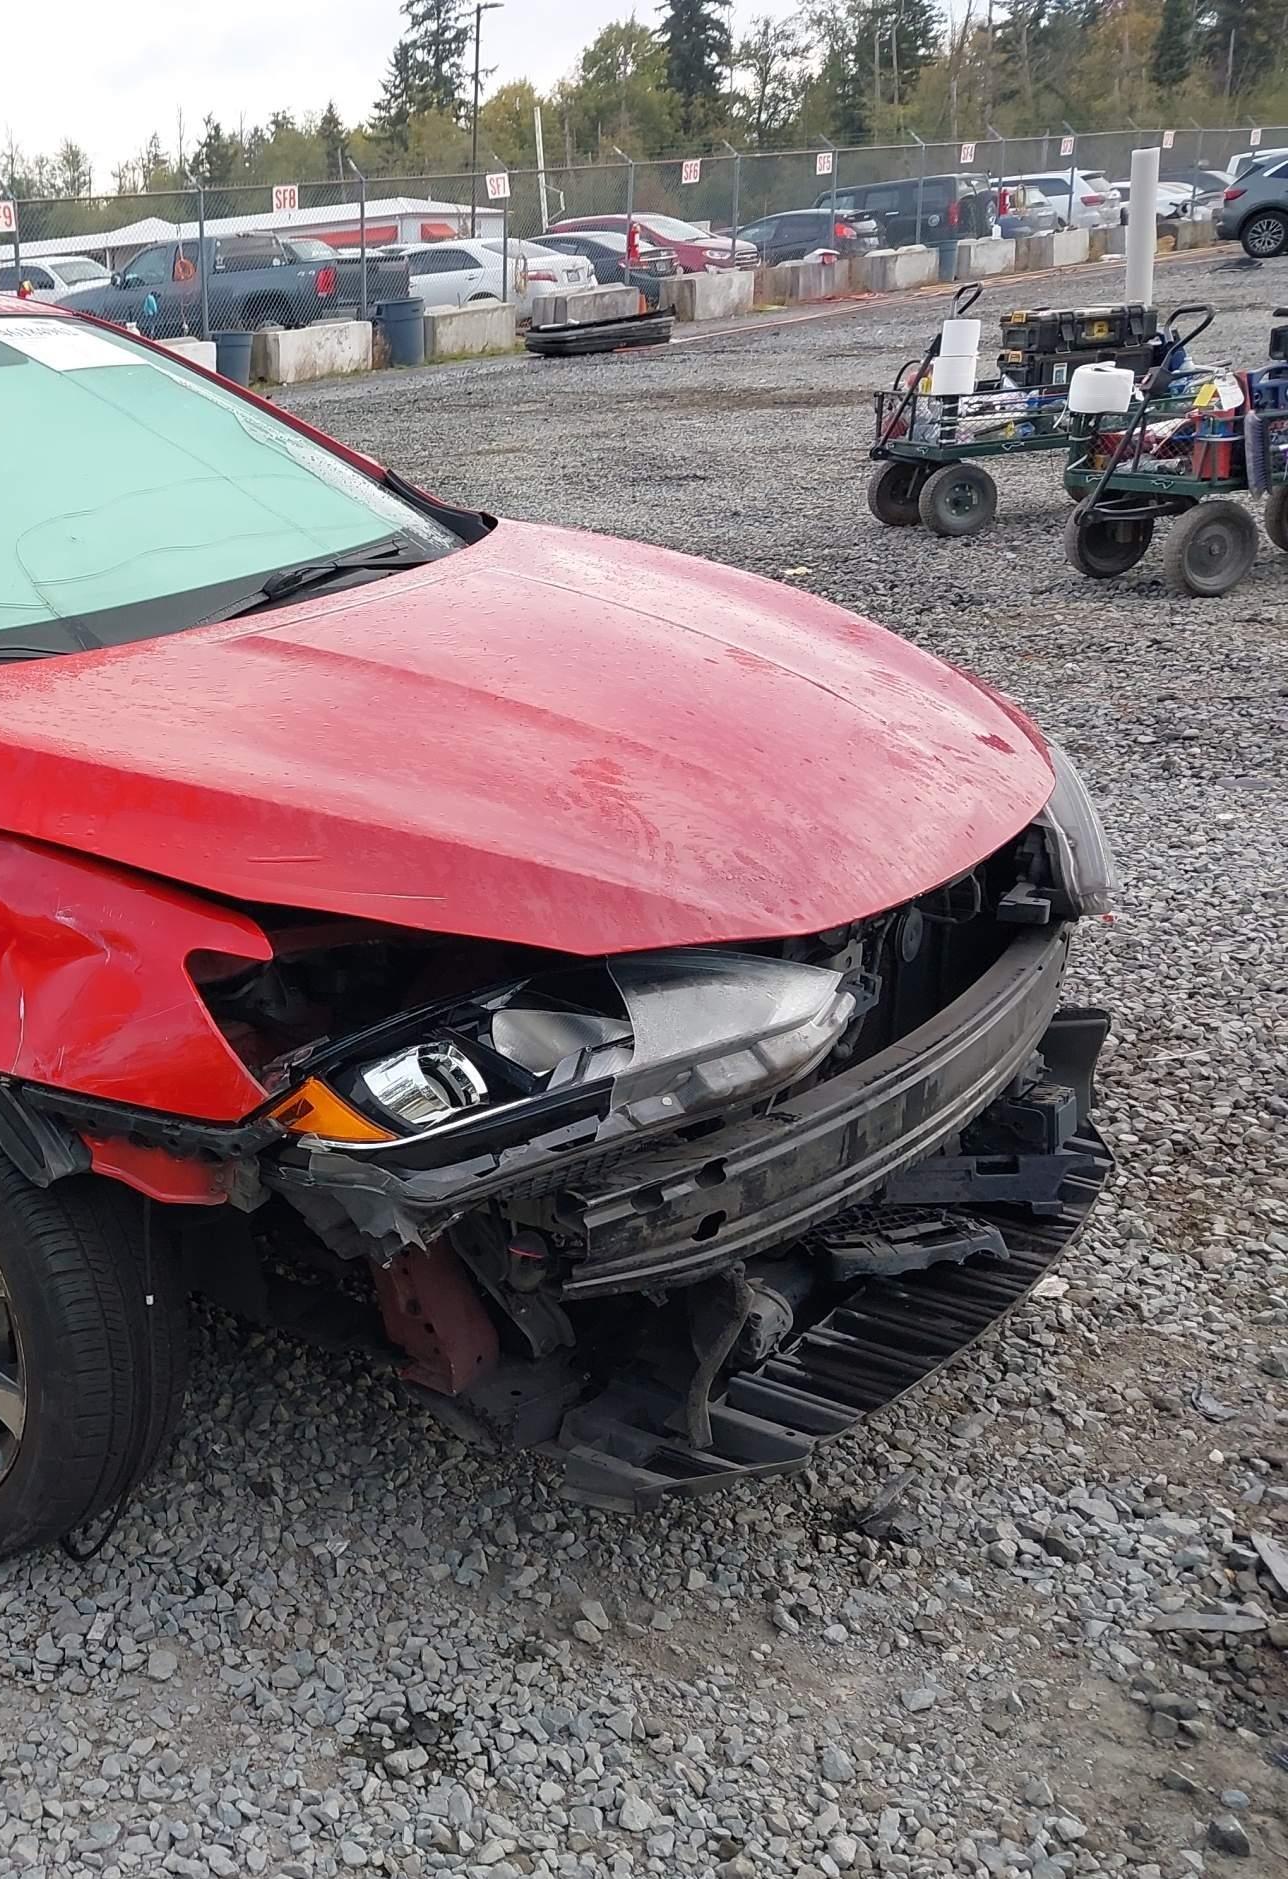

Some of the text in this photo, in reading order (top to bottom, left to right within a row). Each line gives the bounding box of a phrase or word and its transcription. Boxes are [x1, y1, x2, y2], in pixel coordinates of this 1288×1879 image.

[962, 145, 974, 161] SF4
[684, 162, 699, 181] SF6
[818, 154, 831, 172] SF5
[489, 176, 506, 196] SF7
[275, 188, 296, 209] SF8
